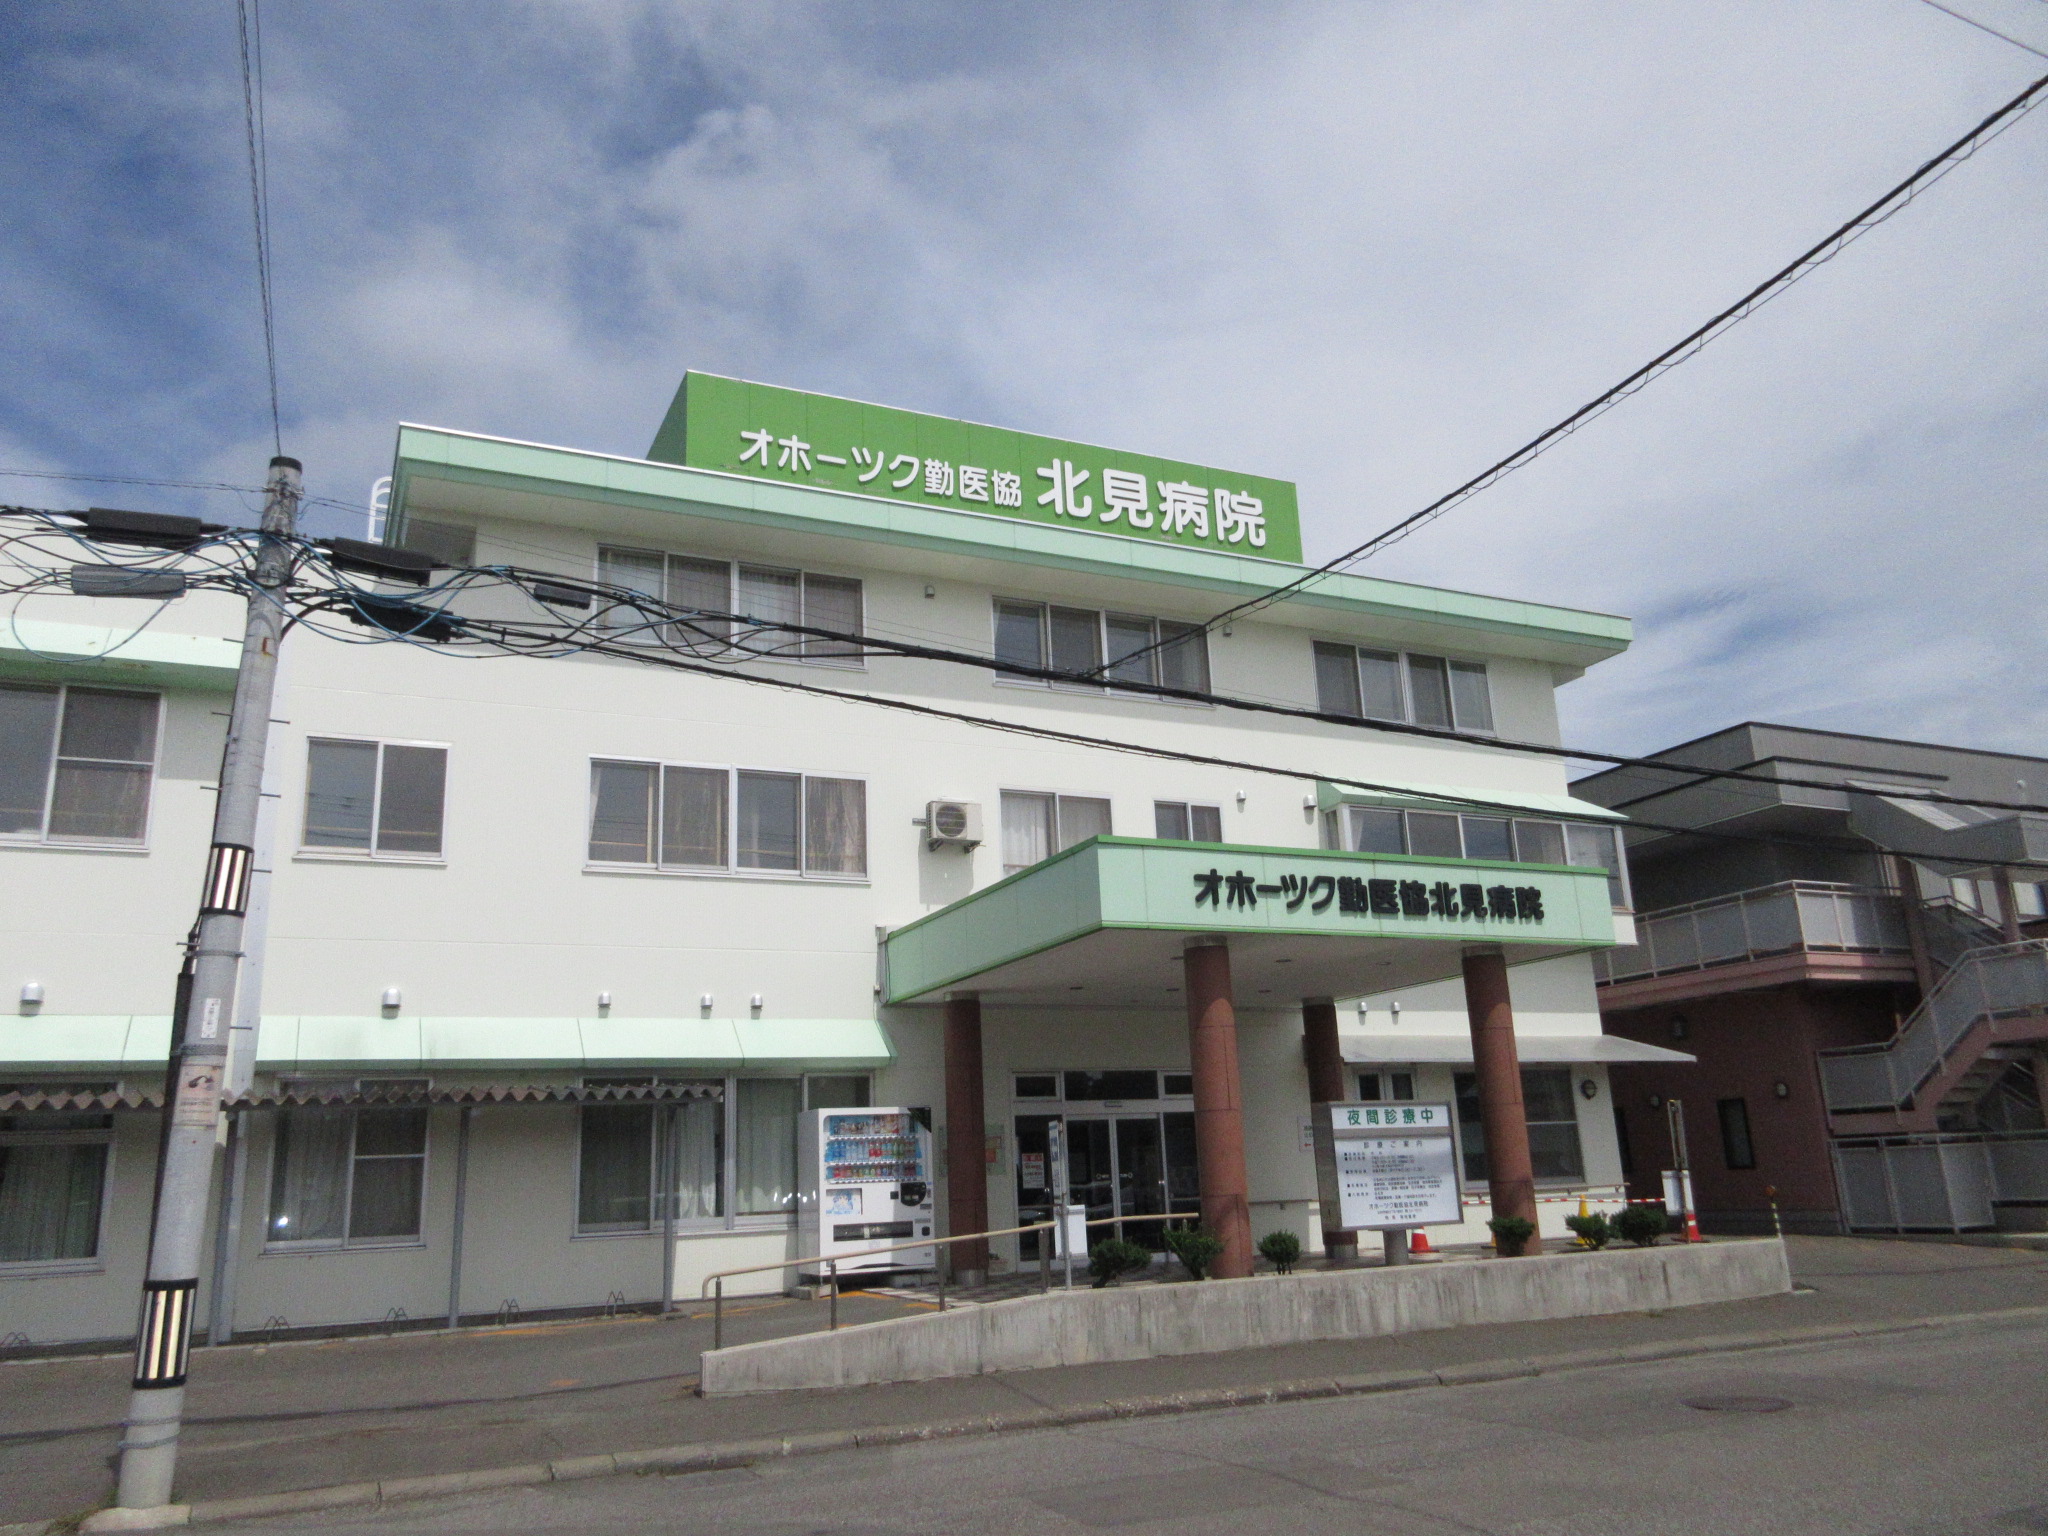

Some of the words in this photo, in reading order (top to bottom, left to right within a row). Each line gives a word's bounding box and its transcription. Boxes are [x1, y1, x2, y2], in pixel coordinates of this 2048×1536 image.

[740, 428, 1022, 507] オホーツク勤医協
[1035, 457, 1267, 547] 北見病院
[1194, 868, 1545, 920] オホーツク勤医協北見病院
[1347, 1108, 1434, 1126] 夜間診療中
